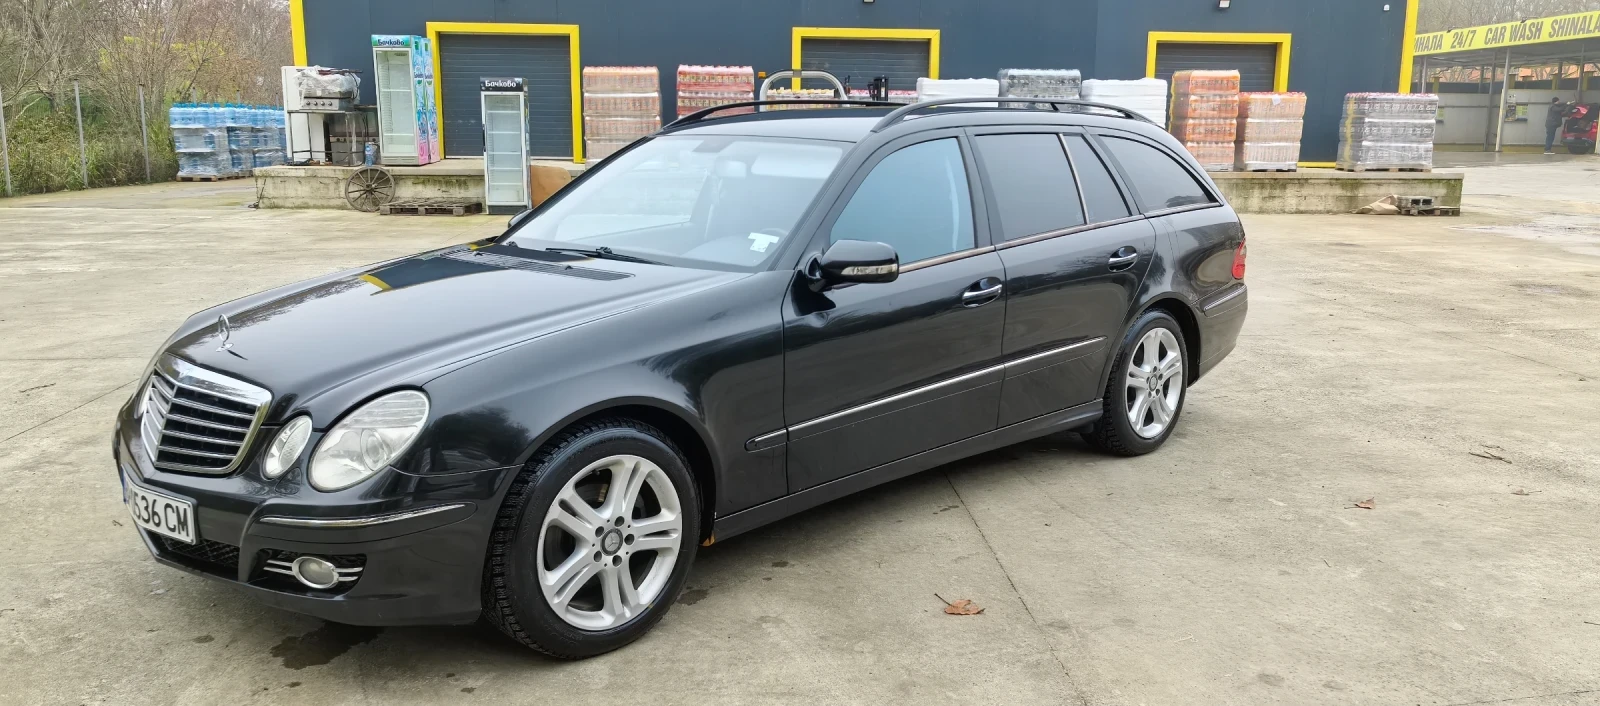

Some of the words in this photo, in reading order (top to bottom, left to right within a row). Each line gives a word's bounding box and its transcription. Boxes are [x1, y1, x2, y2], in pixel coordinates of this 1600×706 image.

[1450, 29, 1477, 49] 24/7
[1484, 25, 1507, 46] CAR
[1509, 21, 1544, 42] WASH
[377, 38, 405, 46] Бачково
[485, 79, 517, 88] Бачково
